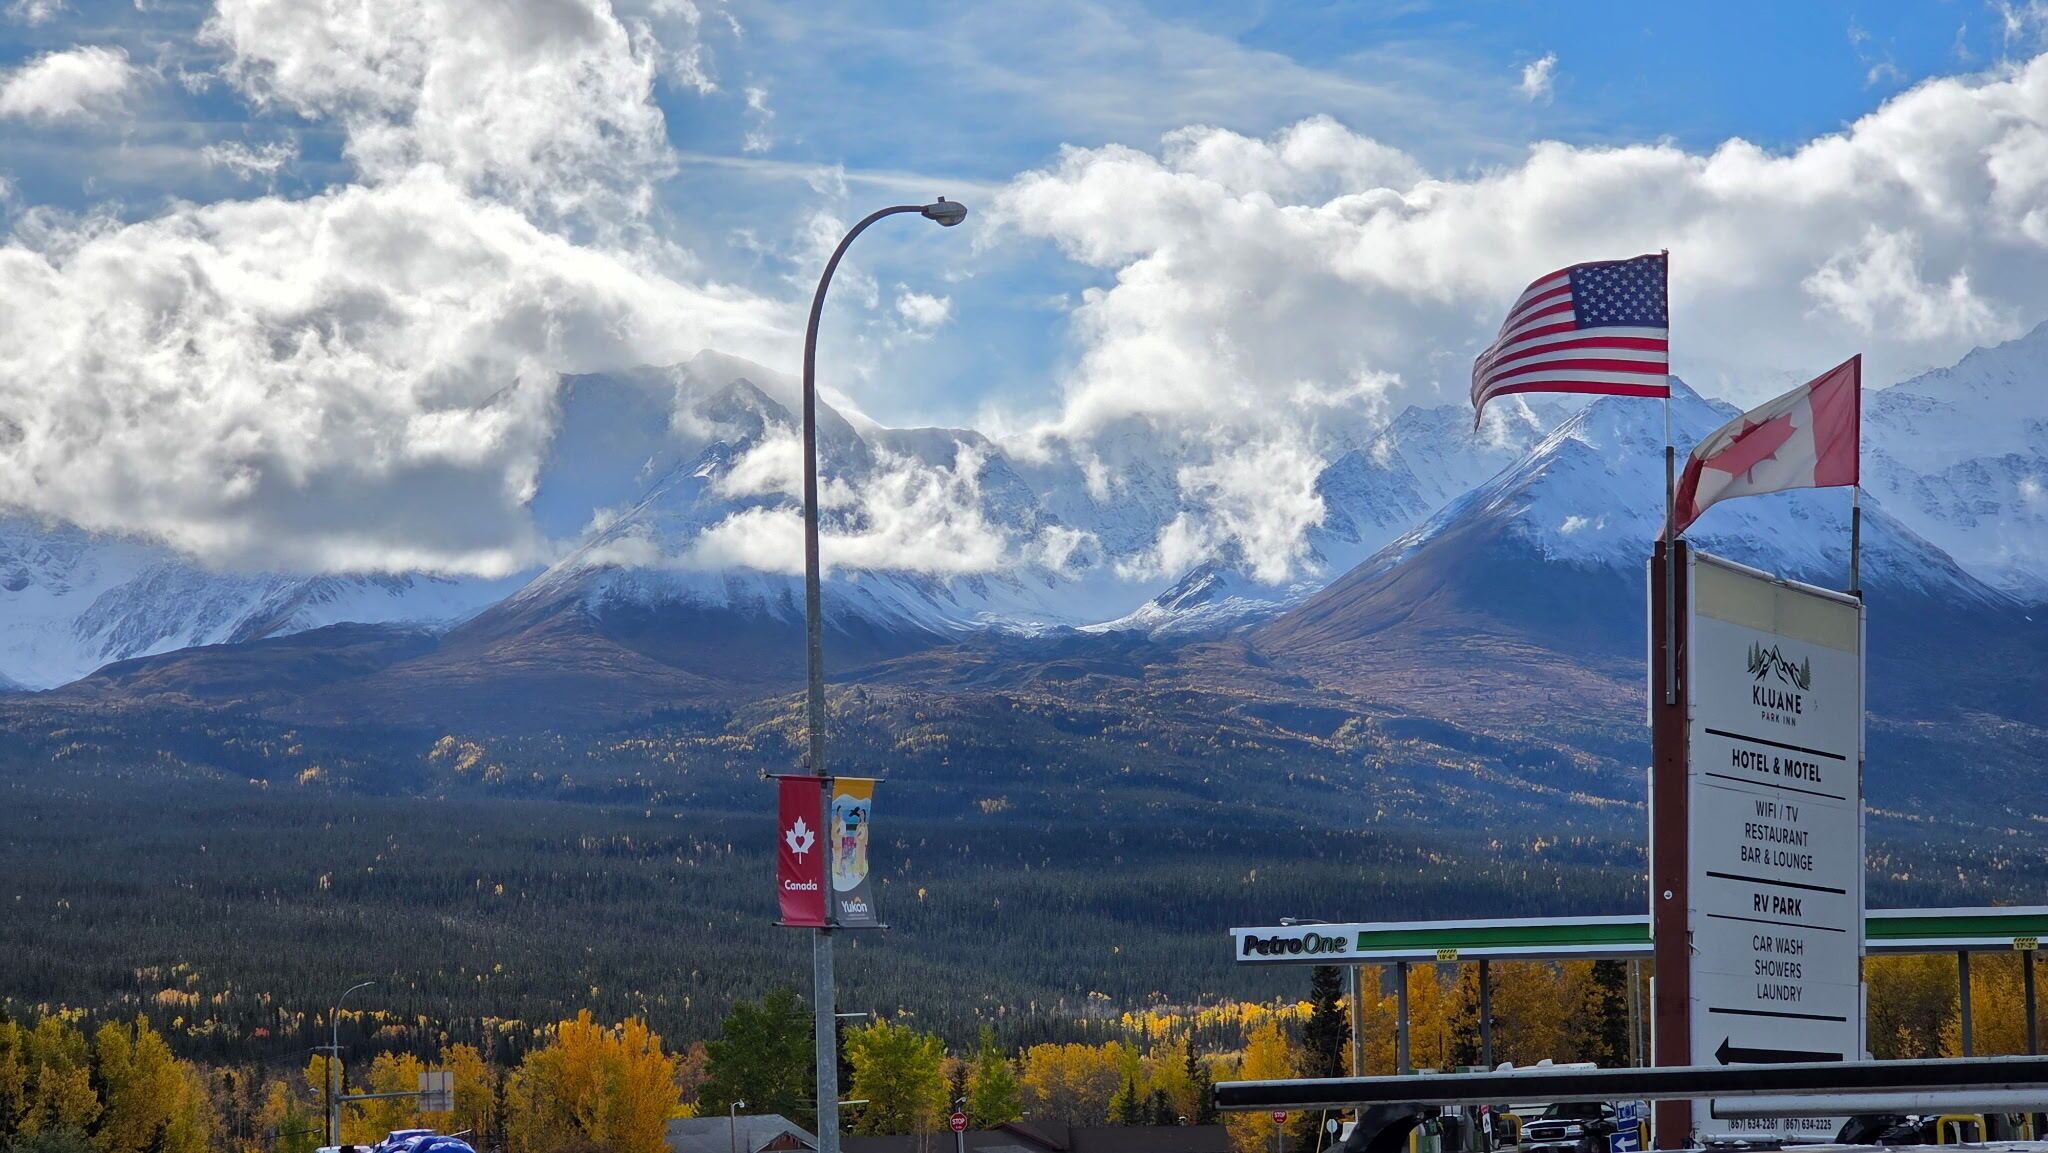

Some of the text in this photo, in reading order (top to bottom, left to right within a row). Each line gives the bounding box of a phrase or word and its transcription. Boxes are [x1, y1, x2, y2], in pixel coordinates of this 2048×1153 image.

[1752, 684, 1802, 715] KLUANE
[1761, 711, 1796, 727] PARK INN
[1732, 748, 1822, 783] HOTEL & MOTEL
[1755, 800, 1799, 823] WIFI / TV
[1745, 822, 1809, 847] RESTAURANT
[1741, 846, 1813, 871] BAR & LOUNGE
[784, 879, 818, 891] Canada
[841, 900, 868, 913] Yukon
[1753, 893, 1802, 917] RV PARK
[1243, 932, 1348, 956] PetroOne
[1752, 935, 1804, 956] CAR WASH
[1754, 959, 1802, 980] SHOWERS
[1756, 983, 1803, 1003] LAUNDRY
[1728, 1118, 1832, 1132] (867) 634-2261 (867) 634-2225
